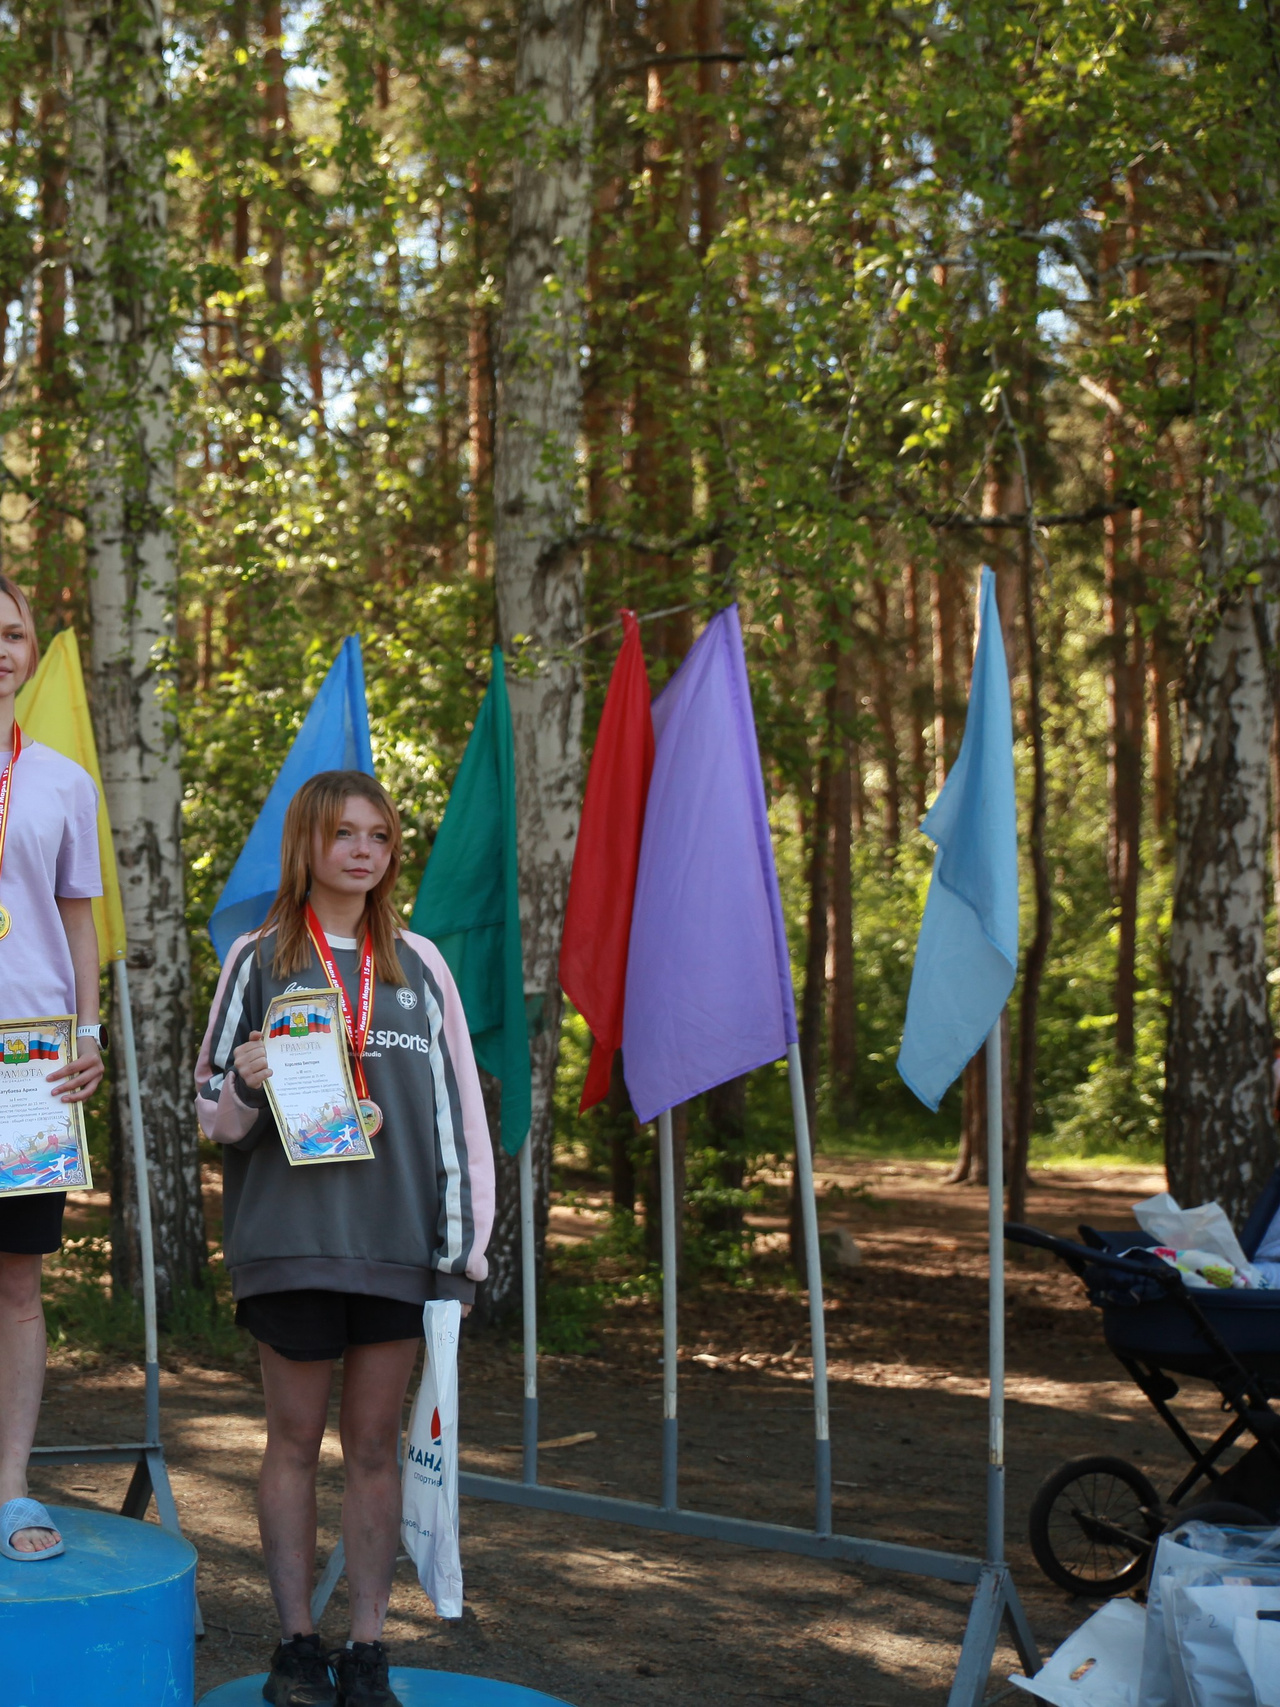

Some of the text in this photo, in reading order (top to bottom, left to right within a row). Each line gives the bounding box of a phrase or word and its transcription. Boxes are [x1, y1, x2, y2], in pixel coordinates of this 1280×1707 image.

[364, 967, 370, 975] 15
[325, 960, 336, 978] Иван
[345, 1015, 352, 1024] 15
[362, 978, 370, 1000] Марья
[280, 1042, 322, 1052] ГРАМОТА
[376, 1030, 429, 1053] sports
